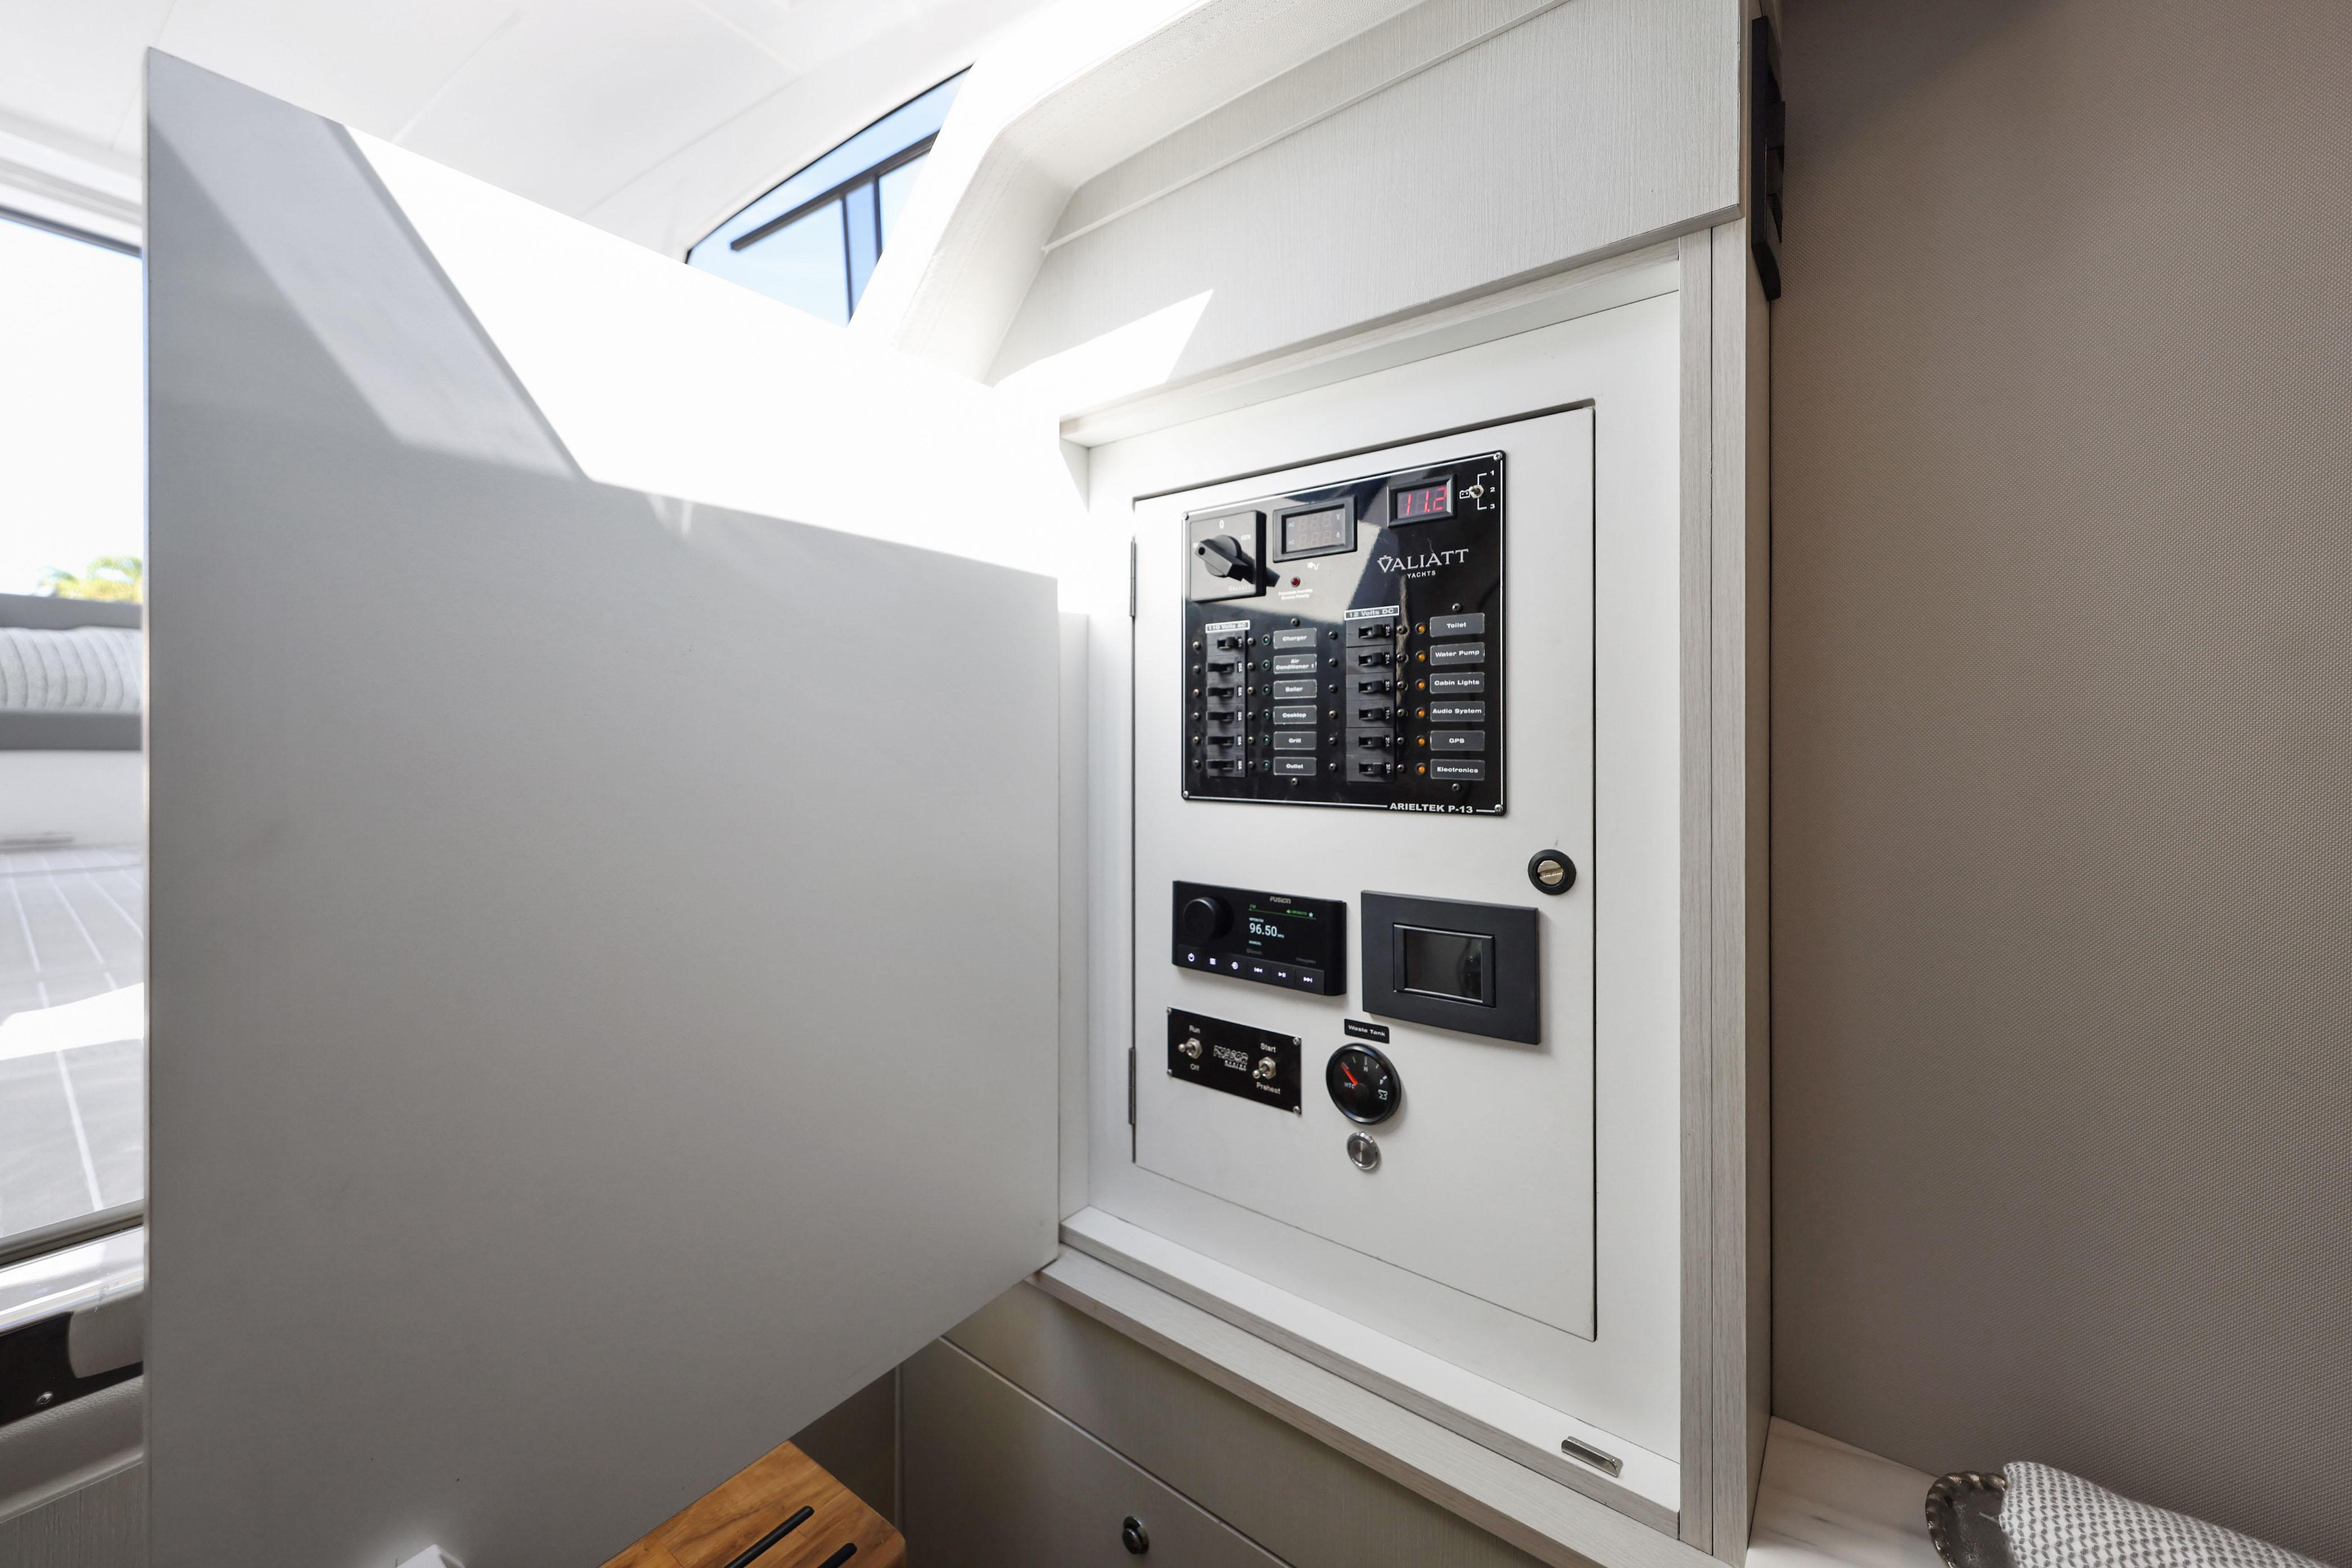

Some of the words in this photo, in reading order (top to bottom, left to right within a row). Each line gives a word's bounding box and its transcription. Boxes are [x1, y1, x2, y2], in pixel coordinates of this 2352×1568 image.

[1406, 487, 1447, 516] 11.2
[1377, 549, 1469, 573] VALIATT
[1407, 570, 1436, 578] YACHTS
[1389, 803, 1445, 812] ARIELTEK
[1448, 805, 1473, 813] P-13
[1249, 923, 1277, 937] 96.50
[1189, 1025, 1201, 1034] Run
[1348, 1024, 1368, 1034] Waste
[1260, 1043, 1276, 1053] Start
[1256, 1082, 1281, 1094] Preheat
